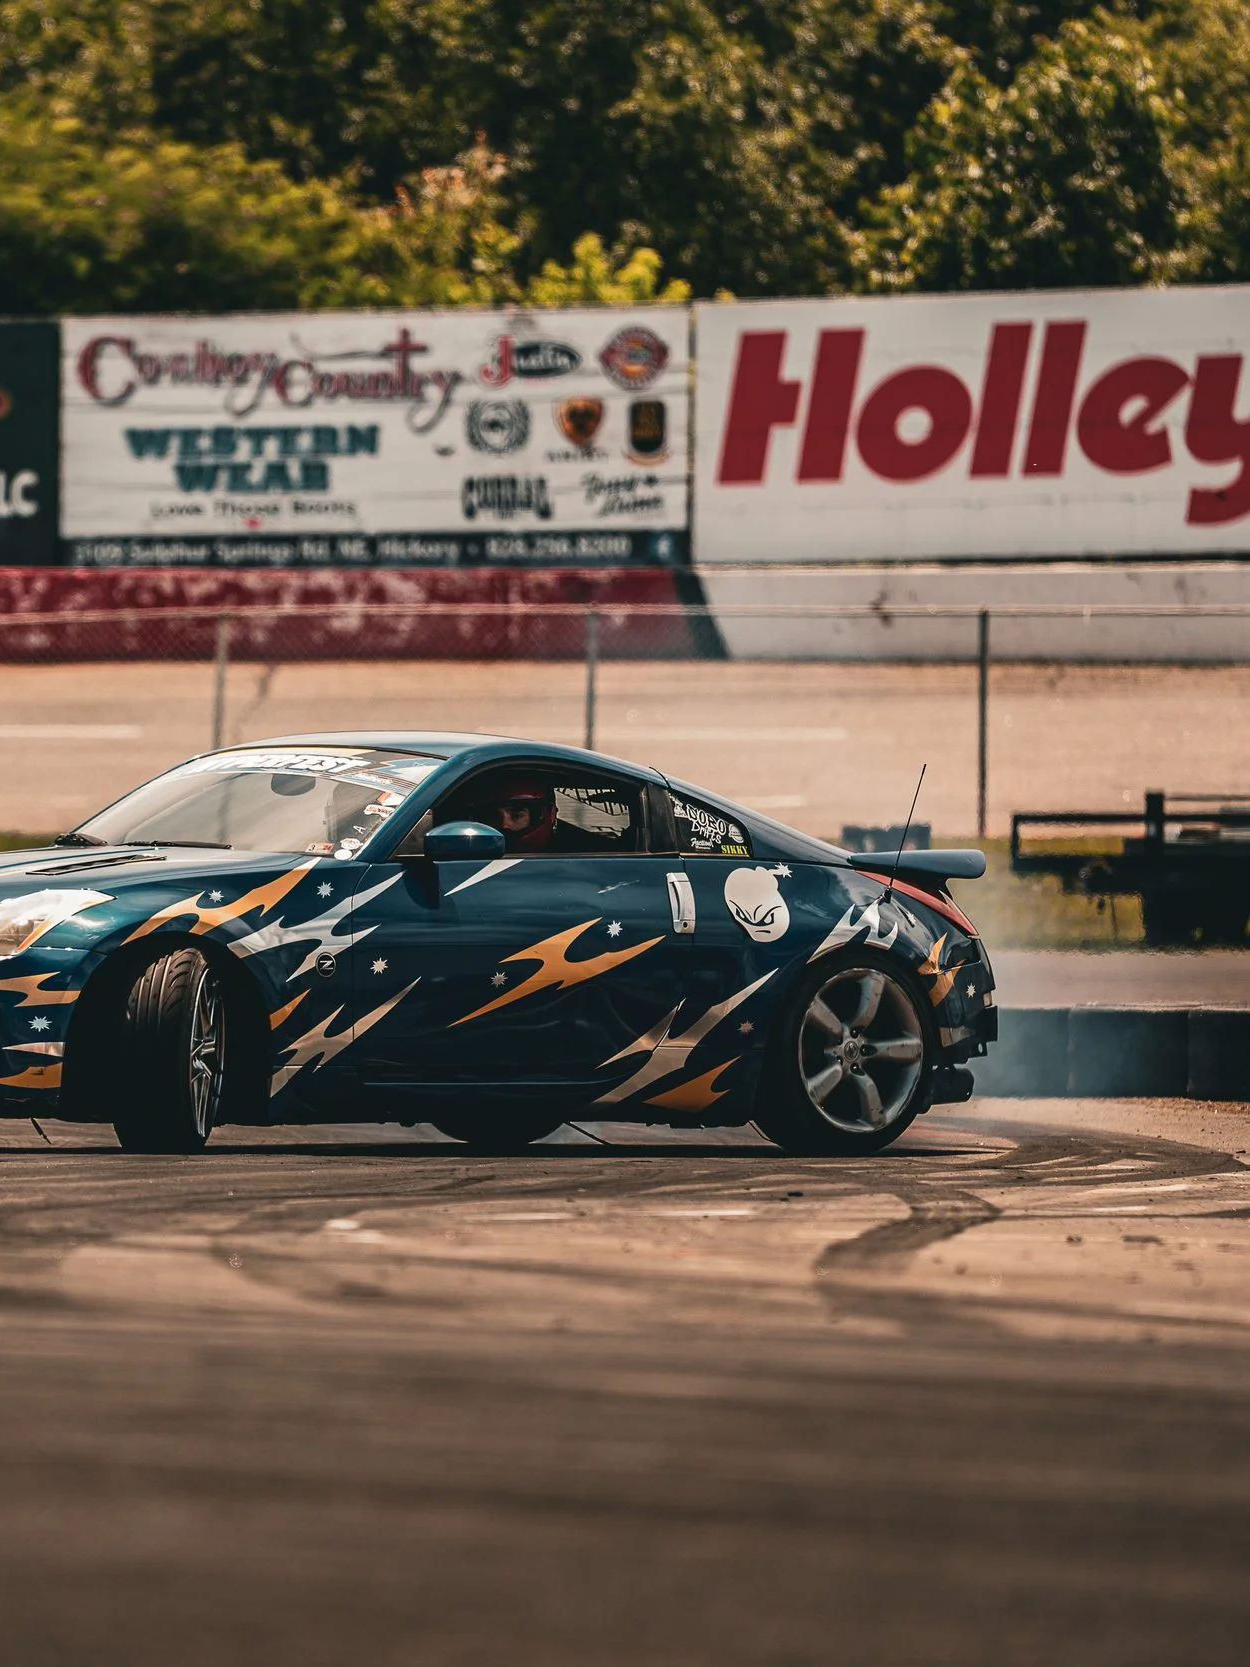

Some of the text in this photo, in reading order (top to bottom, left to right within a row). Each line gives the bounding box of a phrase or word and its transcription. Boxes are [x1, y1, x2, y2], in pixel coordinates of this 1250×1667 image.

[77, 334, 280, 418] Cowboy
[272, 326, 466, 434] Country
[714, 317, 1250, 528] Holley
[124, 424, 380, 459] WESTERN
[174, 459, 331, 493] WEAR
[720, 844, 749, 855] SIKKY
